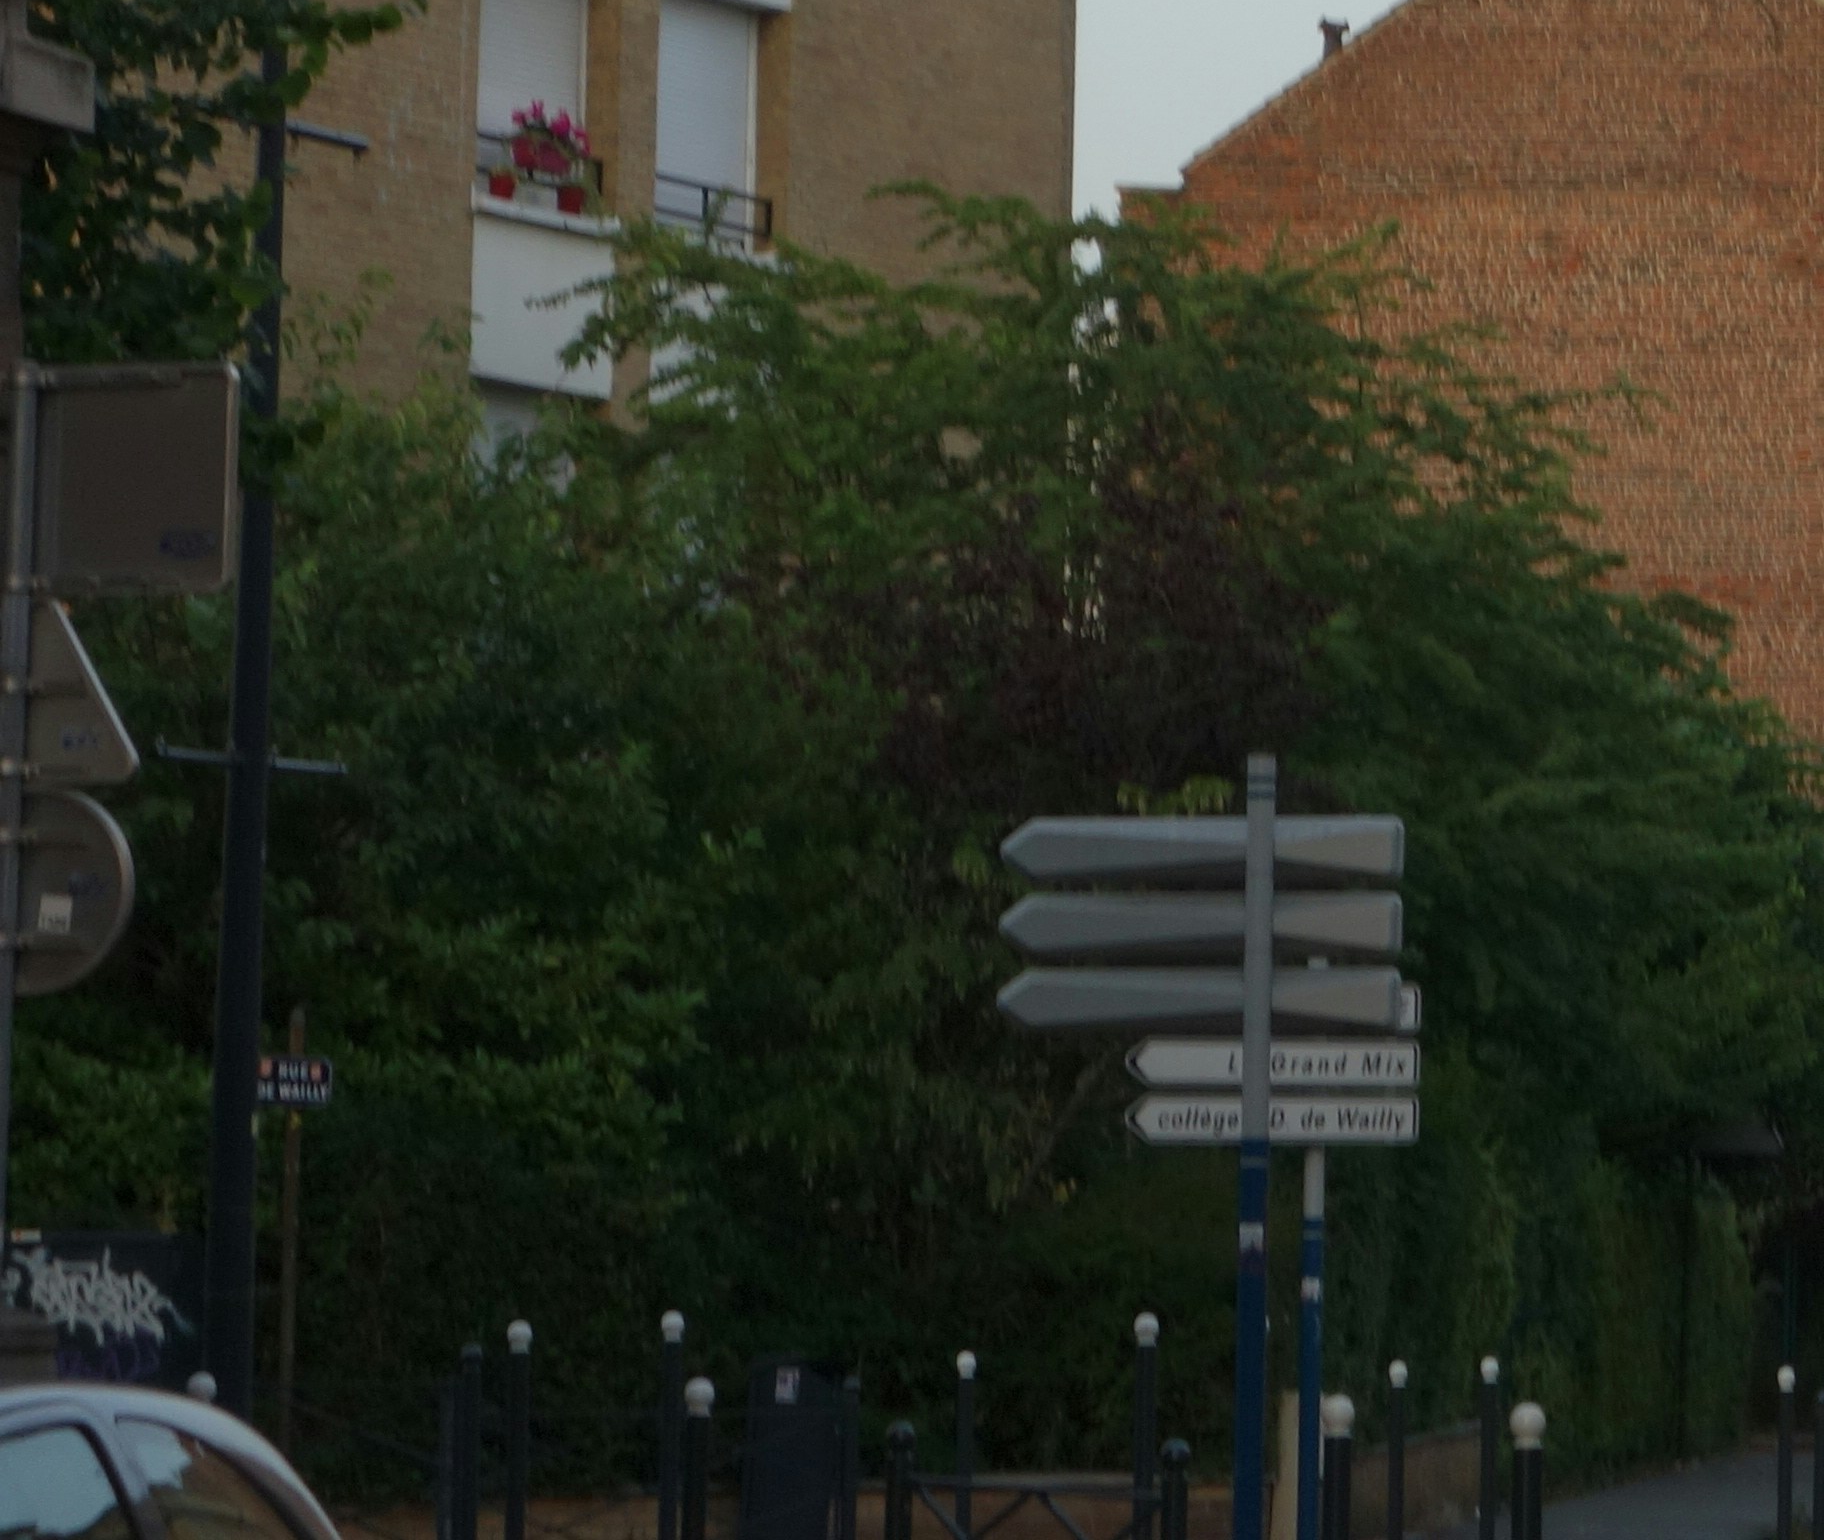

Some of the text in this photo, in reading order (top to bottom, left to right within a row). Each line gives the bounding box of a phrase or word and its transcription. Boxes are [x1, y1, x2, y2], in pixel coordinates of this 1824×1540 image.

[278, 1060, 309, 1081] RUE
[1271, 1050, 1347, 1076] Grand
[1361, 1050, 1406, 1076] Mix
[257, 1080, 327, 1102] DE WAILLY
[1157, 1105, 1239, 1139] collège
[1300, 1105, 1326, 1132] de
[1337, 1105, 1406, 1138] Wailly
